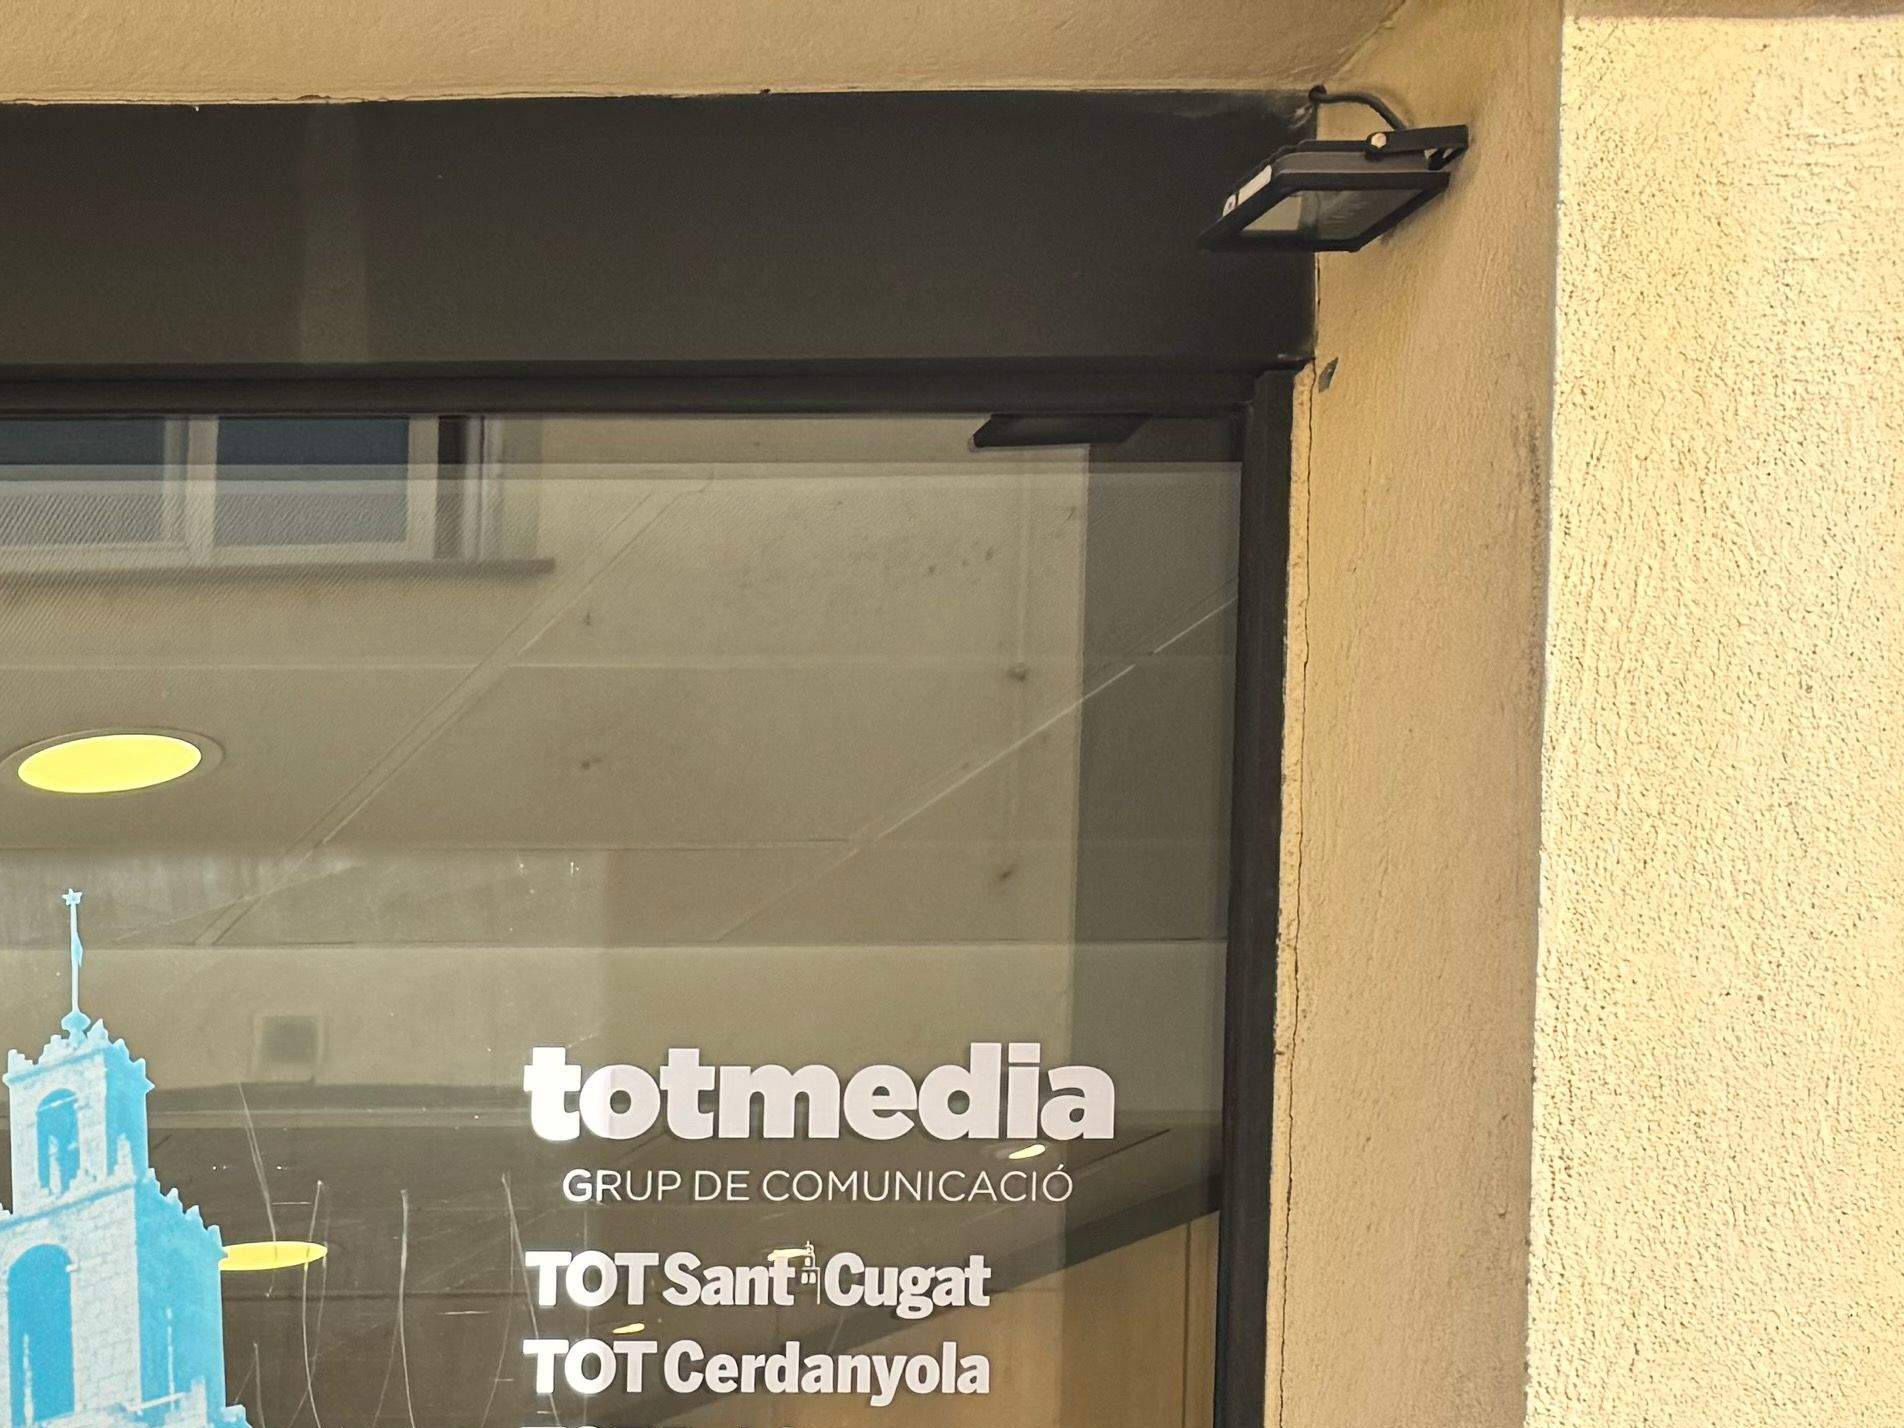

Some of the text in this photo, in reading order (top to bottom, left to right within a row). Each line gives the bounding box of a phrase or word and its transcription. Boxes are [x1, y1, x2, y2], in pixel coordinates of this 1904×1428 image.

[523, 1042, 1114, 1141] totmedia
[562, 1163, 1073, 1203] GRUP DE COMUNICACIÓ
[524, 1251, 991, 1320] TOT Sant Cugat
[523, 1338, 990, 1407] TOT Cerdanyola
